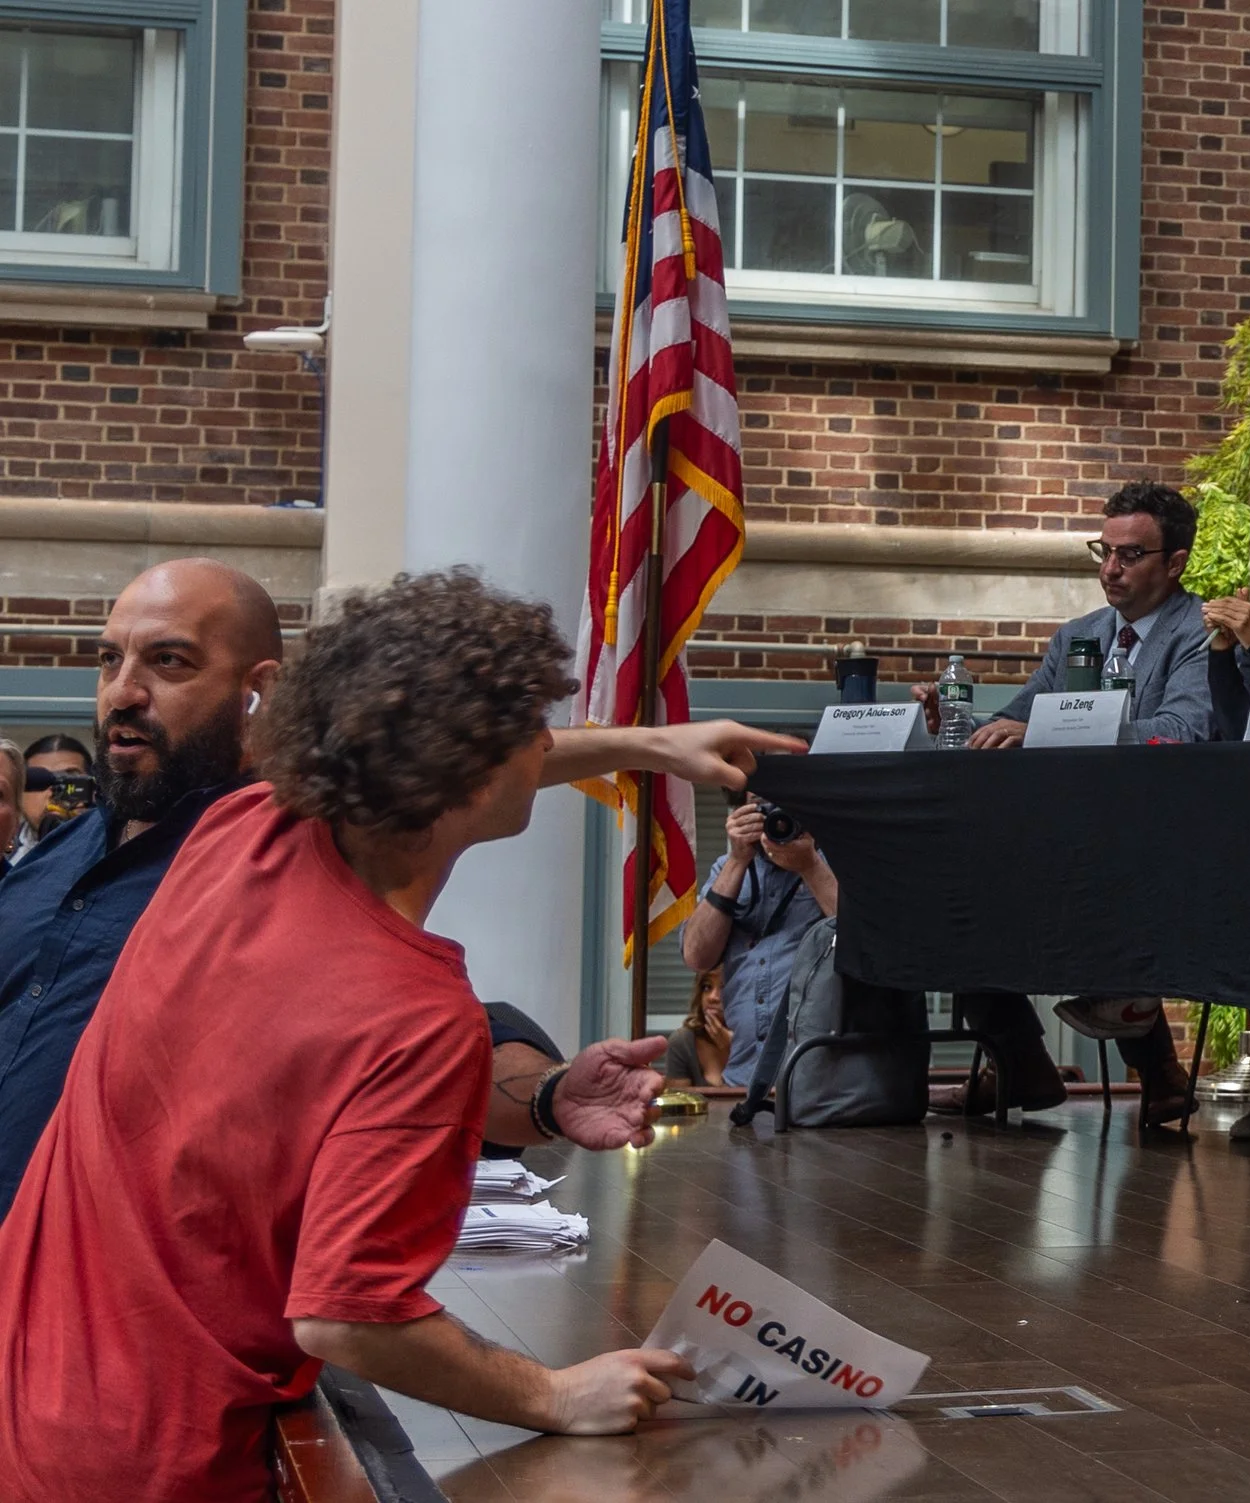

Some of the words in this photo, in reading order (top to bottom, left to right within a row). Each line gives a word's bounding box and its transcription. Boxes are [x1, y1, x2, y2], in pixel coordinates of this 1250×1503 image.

[832, 708, 866, 720] Gregory
[866, 707, 906, 718] Anderson
[1060, 699, 1073, 711] Lin
[1073, 699, 1095, 711] Zeng
[695, 1284, 753, 1327] NO
[757, 1320, 884, 1398] CASINO
[733, 1374, 780, 1406] IN
